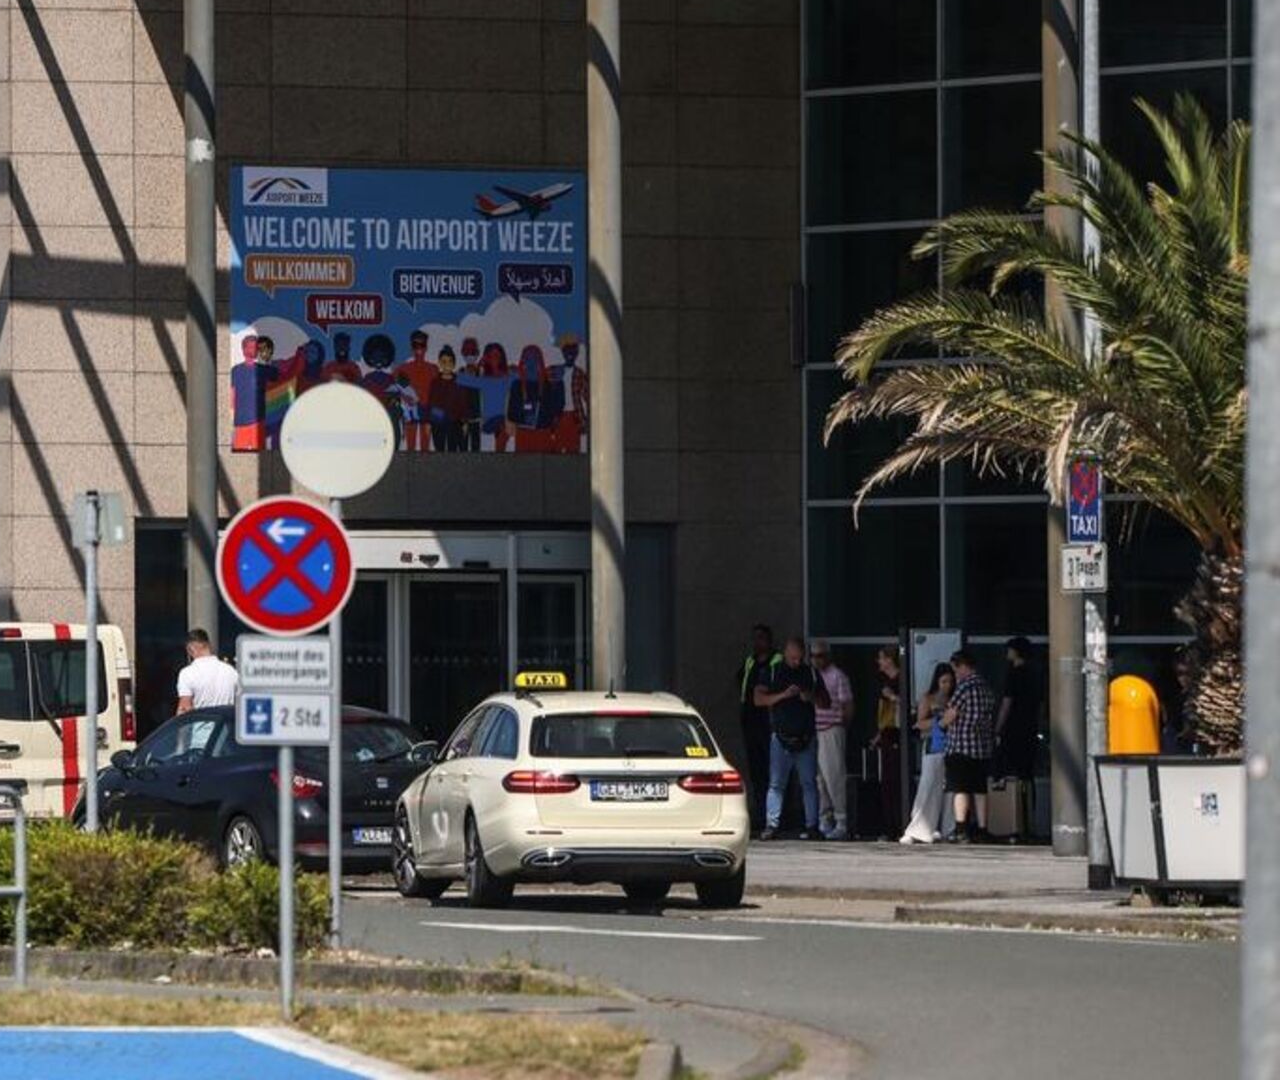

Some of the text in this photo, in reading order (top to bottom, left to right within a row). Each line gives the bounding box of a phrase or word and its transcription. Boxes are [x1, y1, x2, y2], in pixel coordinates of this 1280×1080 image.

[265, 192, 323, 204] AIRPORT WEEZE
[244, 216, 574, 253] WELCOME TO AIRPORT WEEZE
[252, 260, 347, 282] WILLKOMMEN
[399, 274, 476, 295] BIENVENUE
[315, 299, 376, 320] WELKOM
[1071, 514, 1098, 535] TAXI
[249, 649, 324, 661] während des
[245, 665, 328, 680] Ladevorgangs
[526, 674, 561, 685] TAXI
[280, 707, 290, 727] 2
